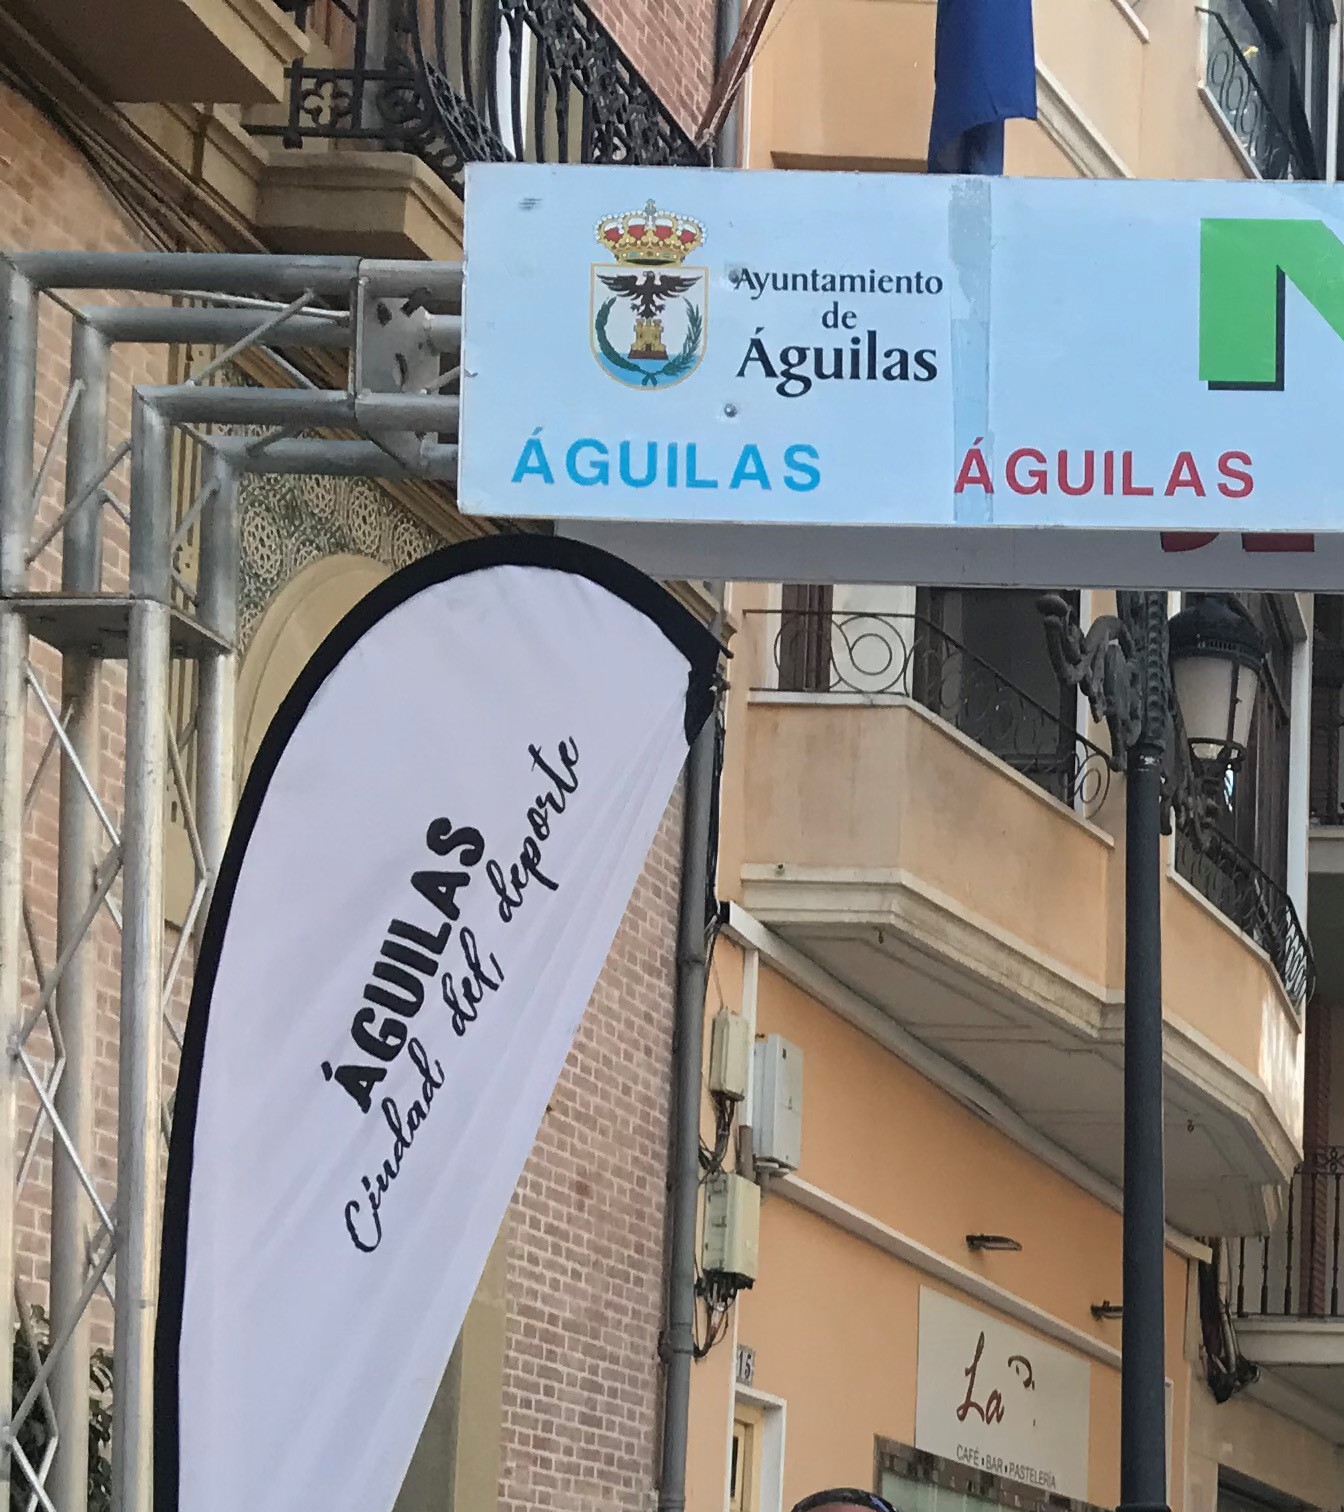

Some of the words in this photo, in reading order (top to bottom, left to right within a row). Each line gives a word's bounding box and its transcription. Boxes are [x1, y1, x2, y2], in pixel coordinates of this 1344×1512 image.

[734, 265, 944, 297] Ayuntamiento
[821, 302, 857, 330] de
[735, 327, 939, 398] Águilas
[512, 427, 821, 492] ÁGUILAS
[955, 437, 1254, 499] ÁGUILAS
[322, 817, 486, 1113] ÁGUILAS
[345, 1039, 444, 1253] Ciudad
[485, 735, 580, 923] deporte
[739, 1351, 751, 1379] 15
[956, 1331, 1004, 1425] La
[956, 1444, 979, 1466] CAFÉ
[986, 1454, 1002, 1473] BAR
